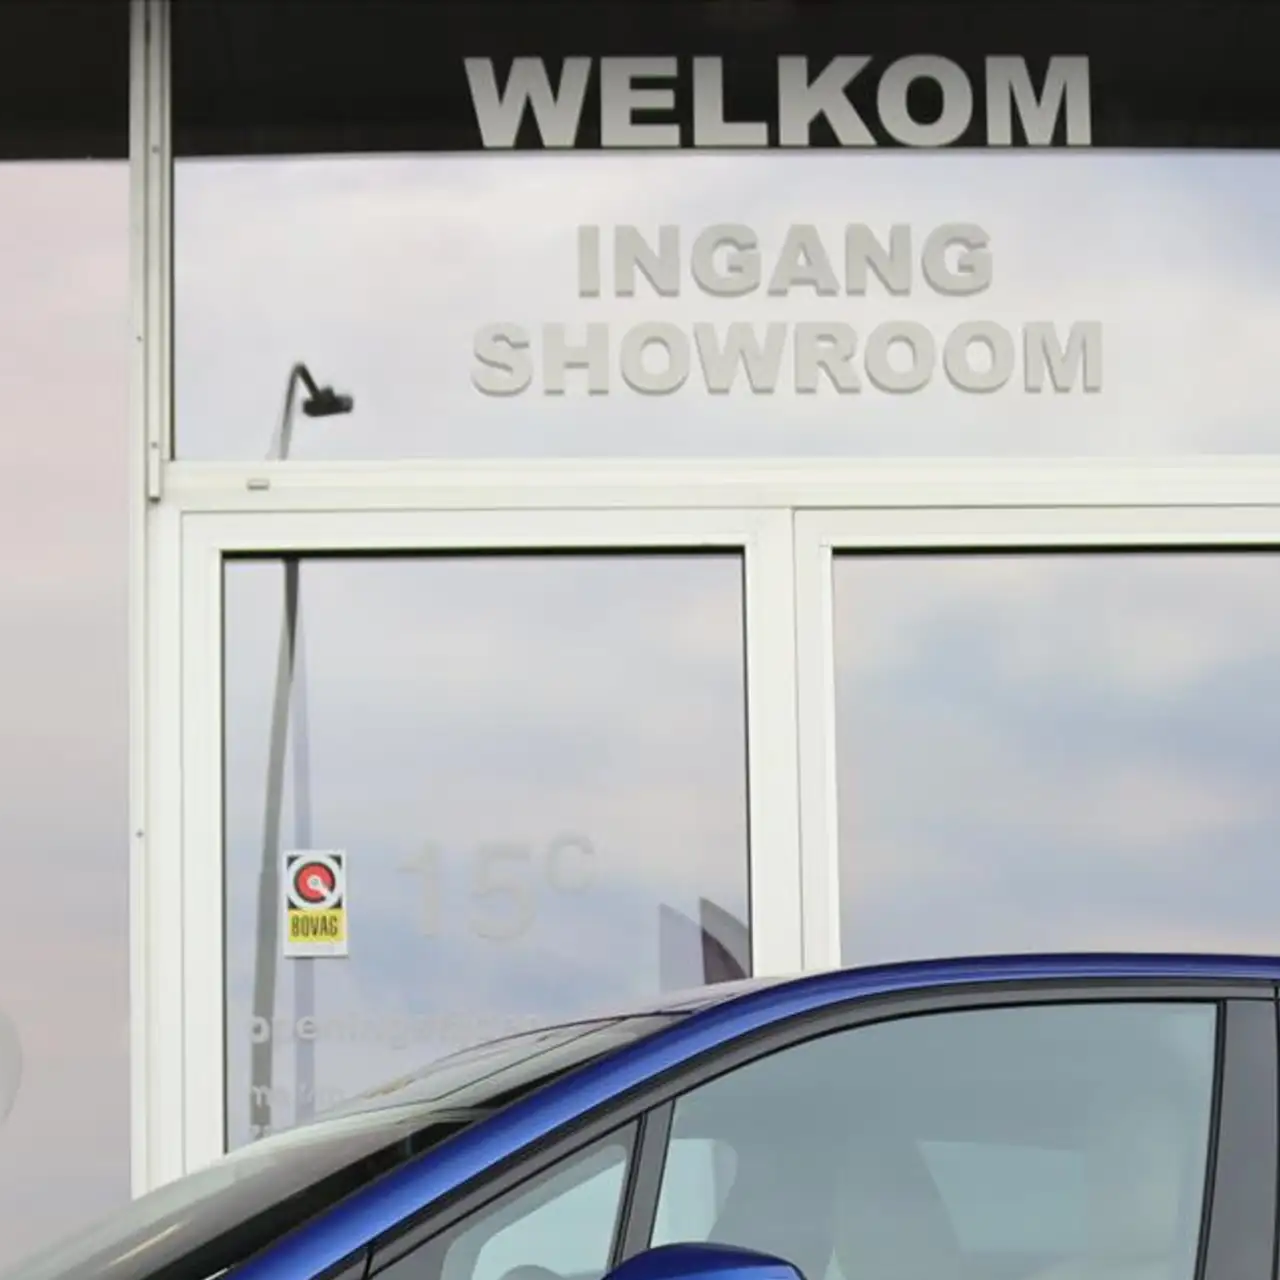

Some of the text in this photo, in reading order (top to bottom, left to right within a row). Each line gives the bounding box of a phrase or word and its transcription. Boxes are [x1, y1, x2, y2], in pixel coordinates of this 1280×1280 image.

[463, 55, 1091, 148] WELKOM
[577, 222, 994, 298] INGANG
[468, 320, 1103, 398] SHOWROOM
